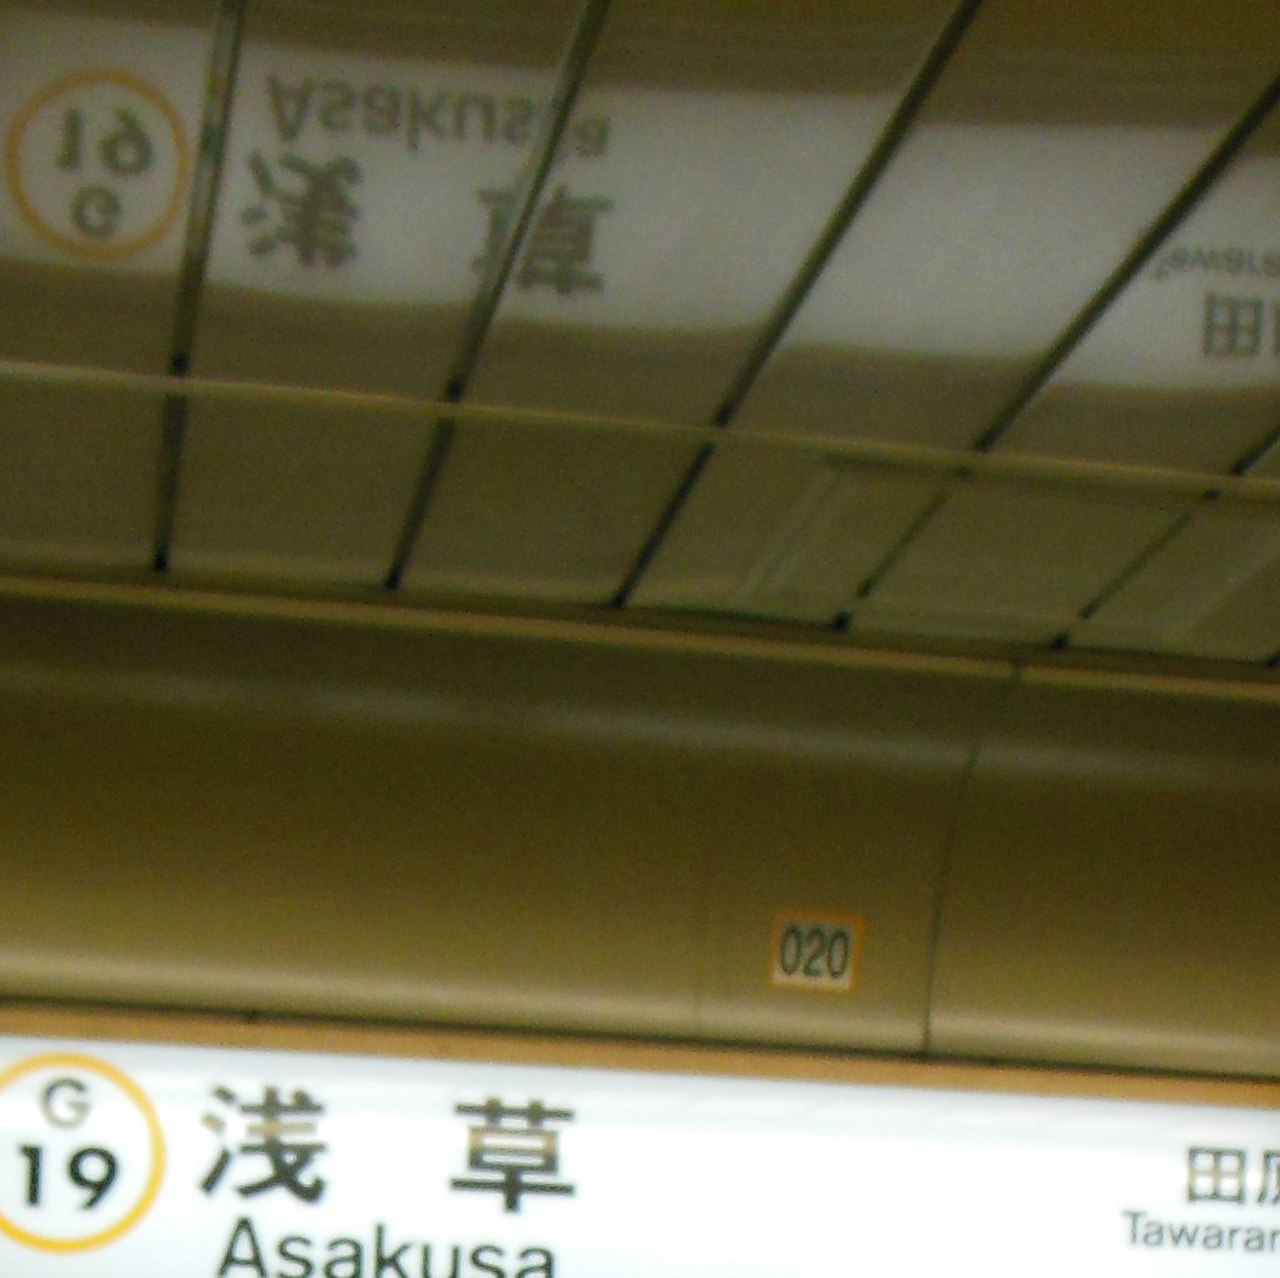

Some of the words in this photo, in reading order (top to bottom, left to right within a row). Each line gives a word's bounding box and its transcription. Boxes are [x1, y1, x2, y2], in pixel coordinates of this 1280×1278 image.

[781, 924, 850, 979] 020
[39, 1078, 91, 1130] G
[18, 1143, 118, 1211] 19
[199, 1083, 575, 1213] 浅草
